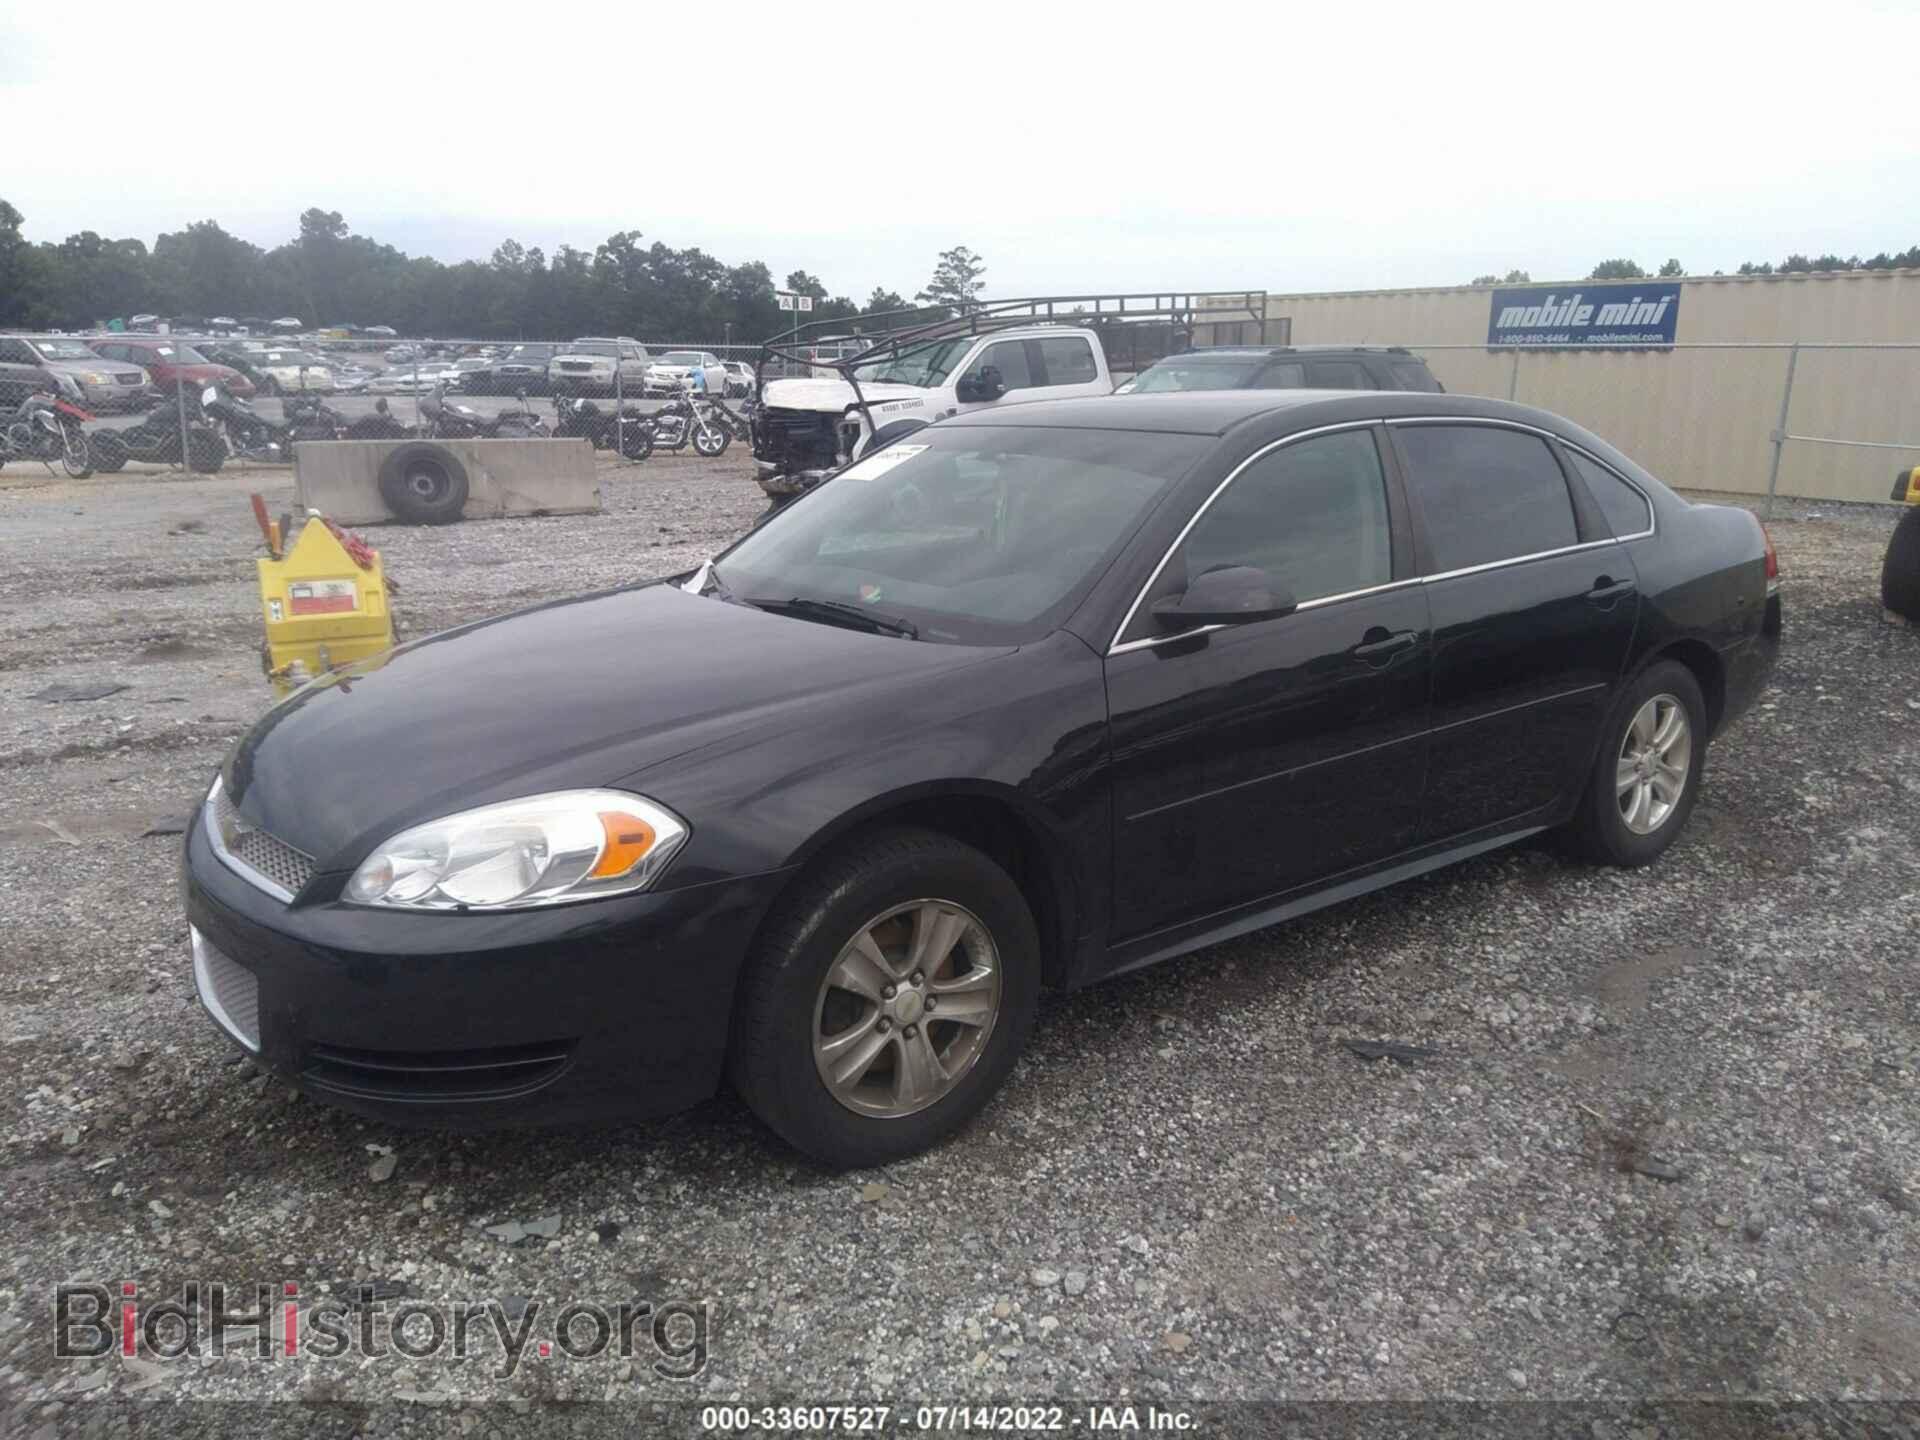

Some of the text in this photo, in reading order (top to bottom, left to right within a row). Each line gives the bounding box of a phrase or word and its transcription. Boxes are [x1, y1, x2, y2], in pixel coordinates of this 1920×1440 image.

[1496, 294, 1670, 328] mobile mini
[1586, 333, 1664, 342] mobilemini.com
